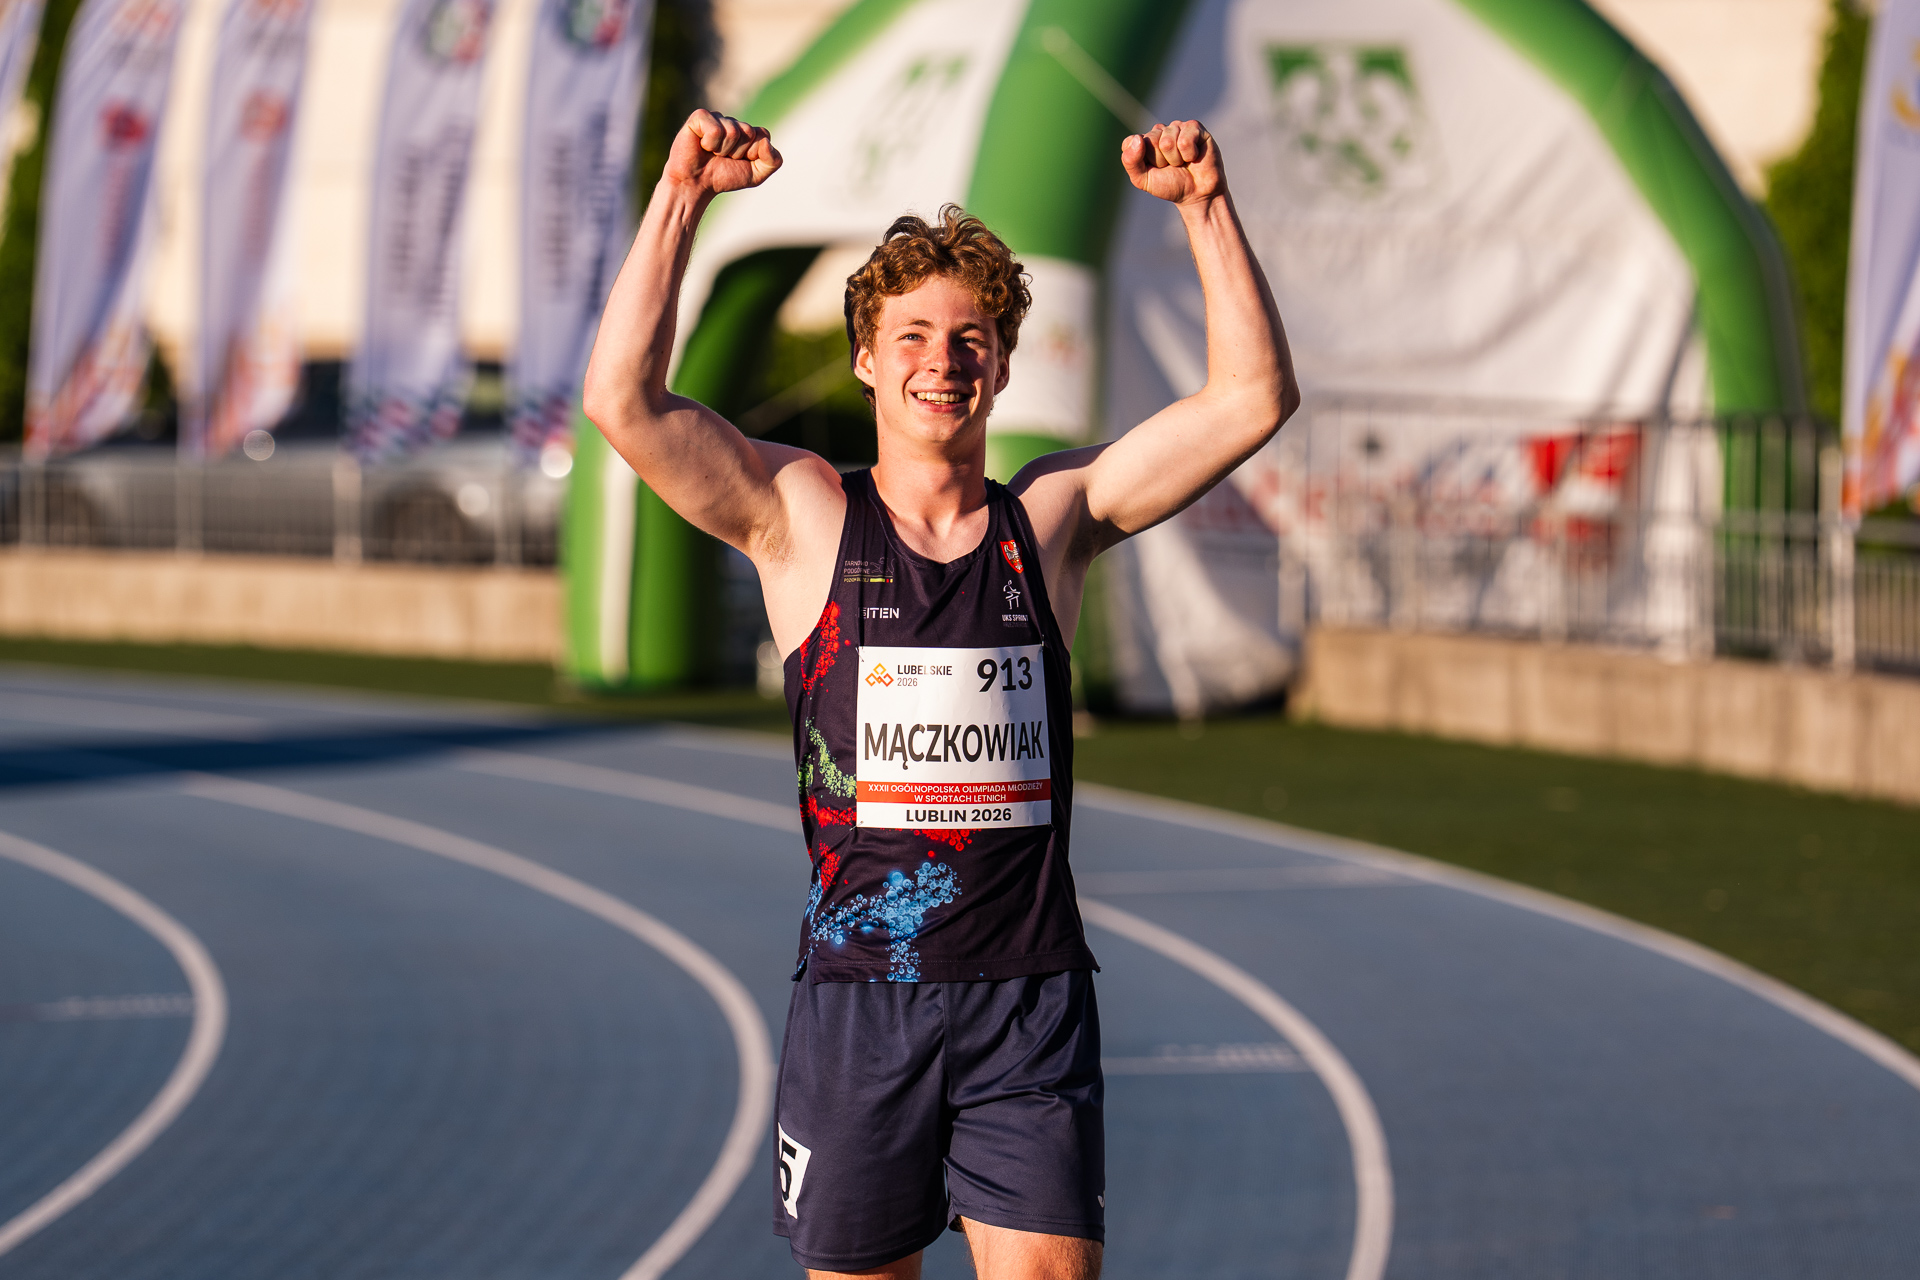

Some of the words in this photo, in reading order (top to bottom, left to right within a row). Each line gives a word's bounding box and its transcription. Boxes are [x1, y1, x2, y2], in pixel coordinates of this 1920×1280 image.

[897, 664, 953, 676] LUBELSKIE
[977, 656, 1033, 692] 913
[897, 677, 918, 687] 2026
[864, 720, 1045, 770] MĄCZKOWIAK
[868, 783, 889, 793] XXXII
[891, 783, 960, 793] OGÓLNOPOLSKA
[962, 784, 1006, 793] OLIMPIADA
[1007, 781, 1043, 792] MŁODZIEŻY
[914, 795, 925, 803] W
[925, 794, 972, 803] SPORTACH
[974, 793, 1007, 803] LETNICH
[906, 809, 967, 823] LUBLIN
[971, 808, 1012, 822] 2026
[780, 1137, 797, 1201] 5
